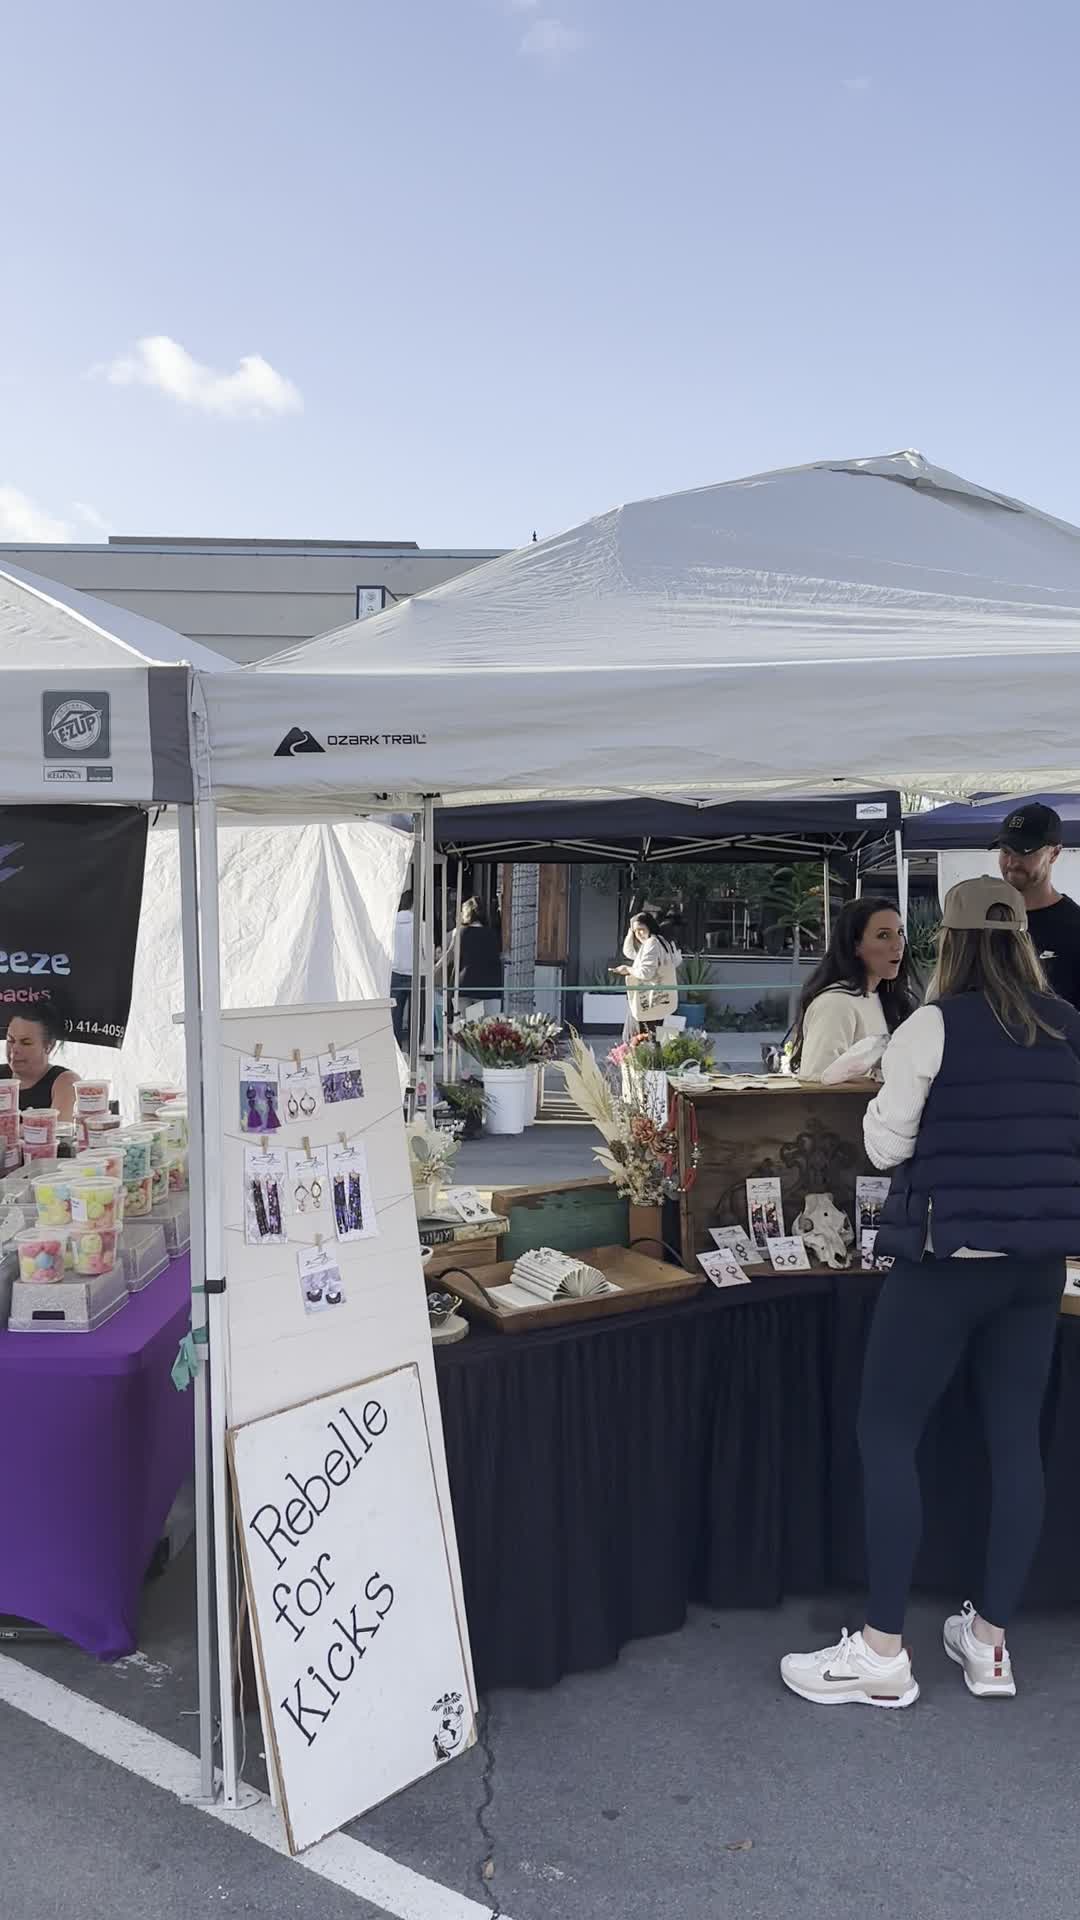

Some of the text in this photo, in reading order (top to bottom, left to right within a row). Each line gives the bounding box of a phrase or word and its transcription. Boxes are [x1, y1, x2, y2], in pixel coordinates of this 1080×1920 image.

[327, 734, 427, 745] OZARK TRAIL
[0, 987, 51, 1002] acks
[249, 1400, 389, 1570] Rebelle
[272, 1551, 336, 1643] for
[280, 1571, 395, 1746] Kicks
